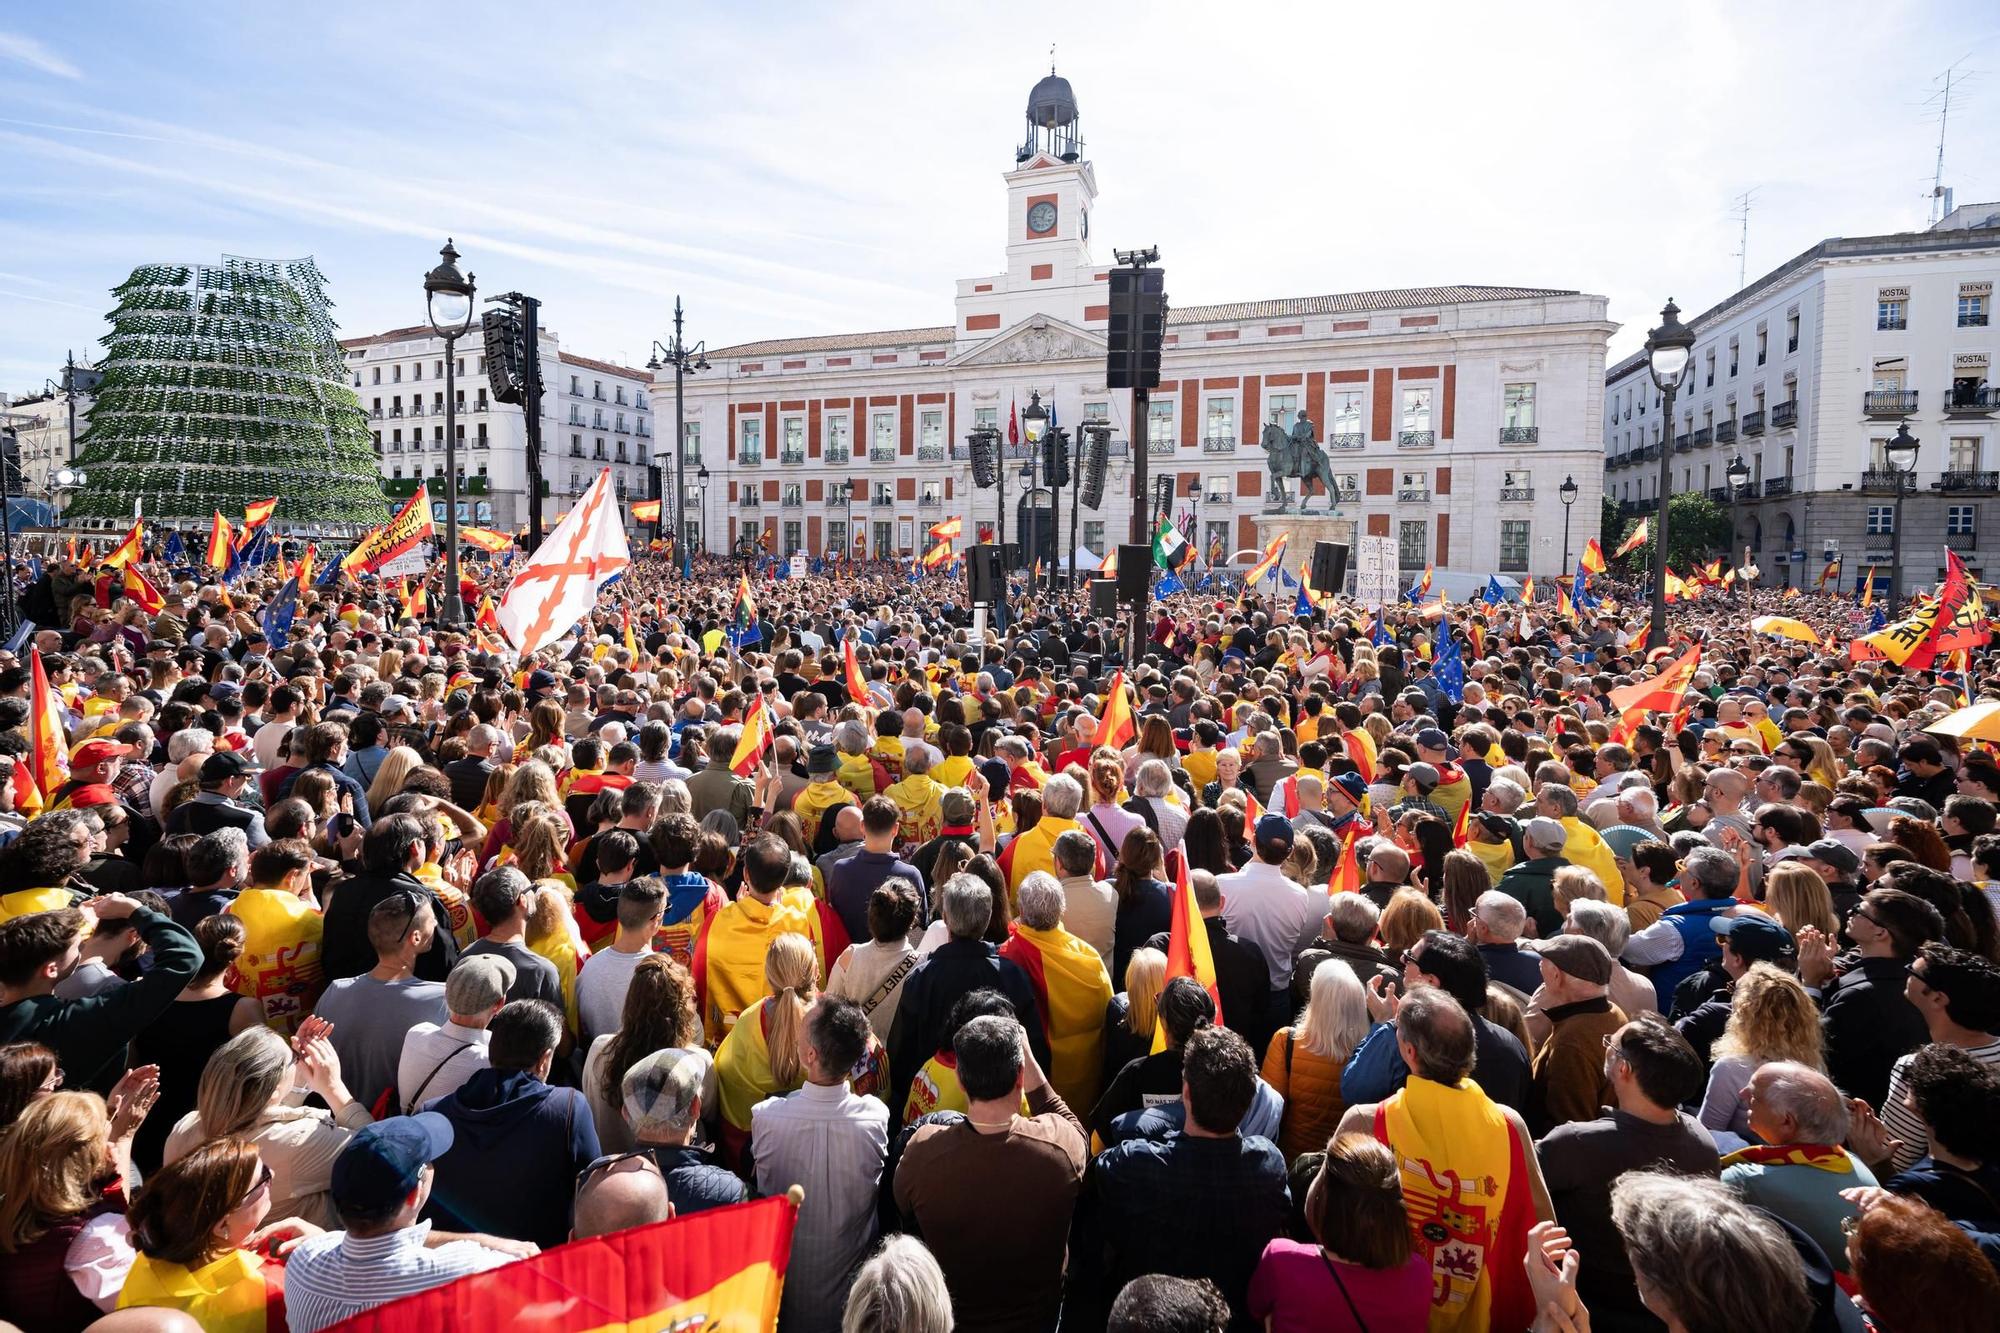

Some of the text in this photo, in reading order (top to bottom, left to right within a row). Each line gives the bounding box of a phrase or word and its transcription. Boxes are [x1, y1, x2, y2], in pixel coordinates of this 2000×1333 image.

[1960, 283, 1992, 292] RIESCO
[1879, 288, 1909, 297] HOSTAL
[1956, 354, 1987, 363] HOSTAL
